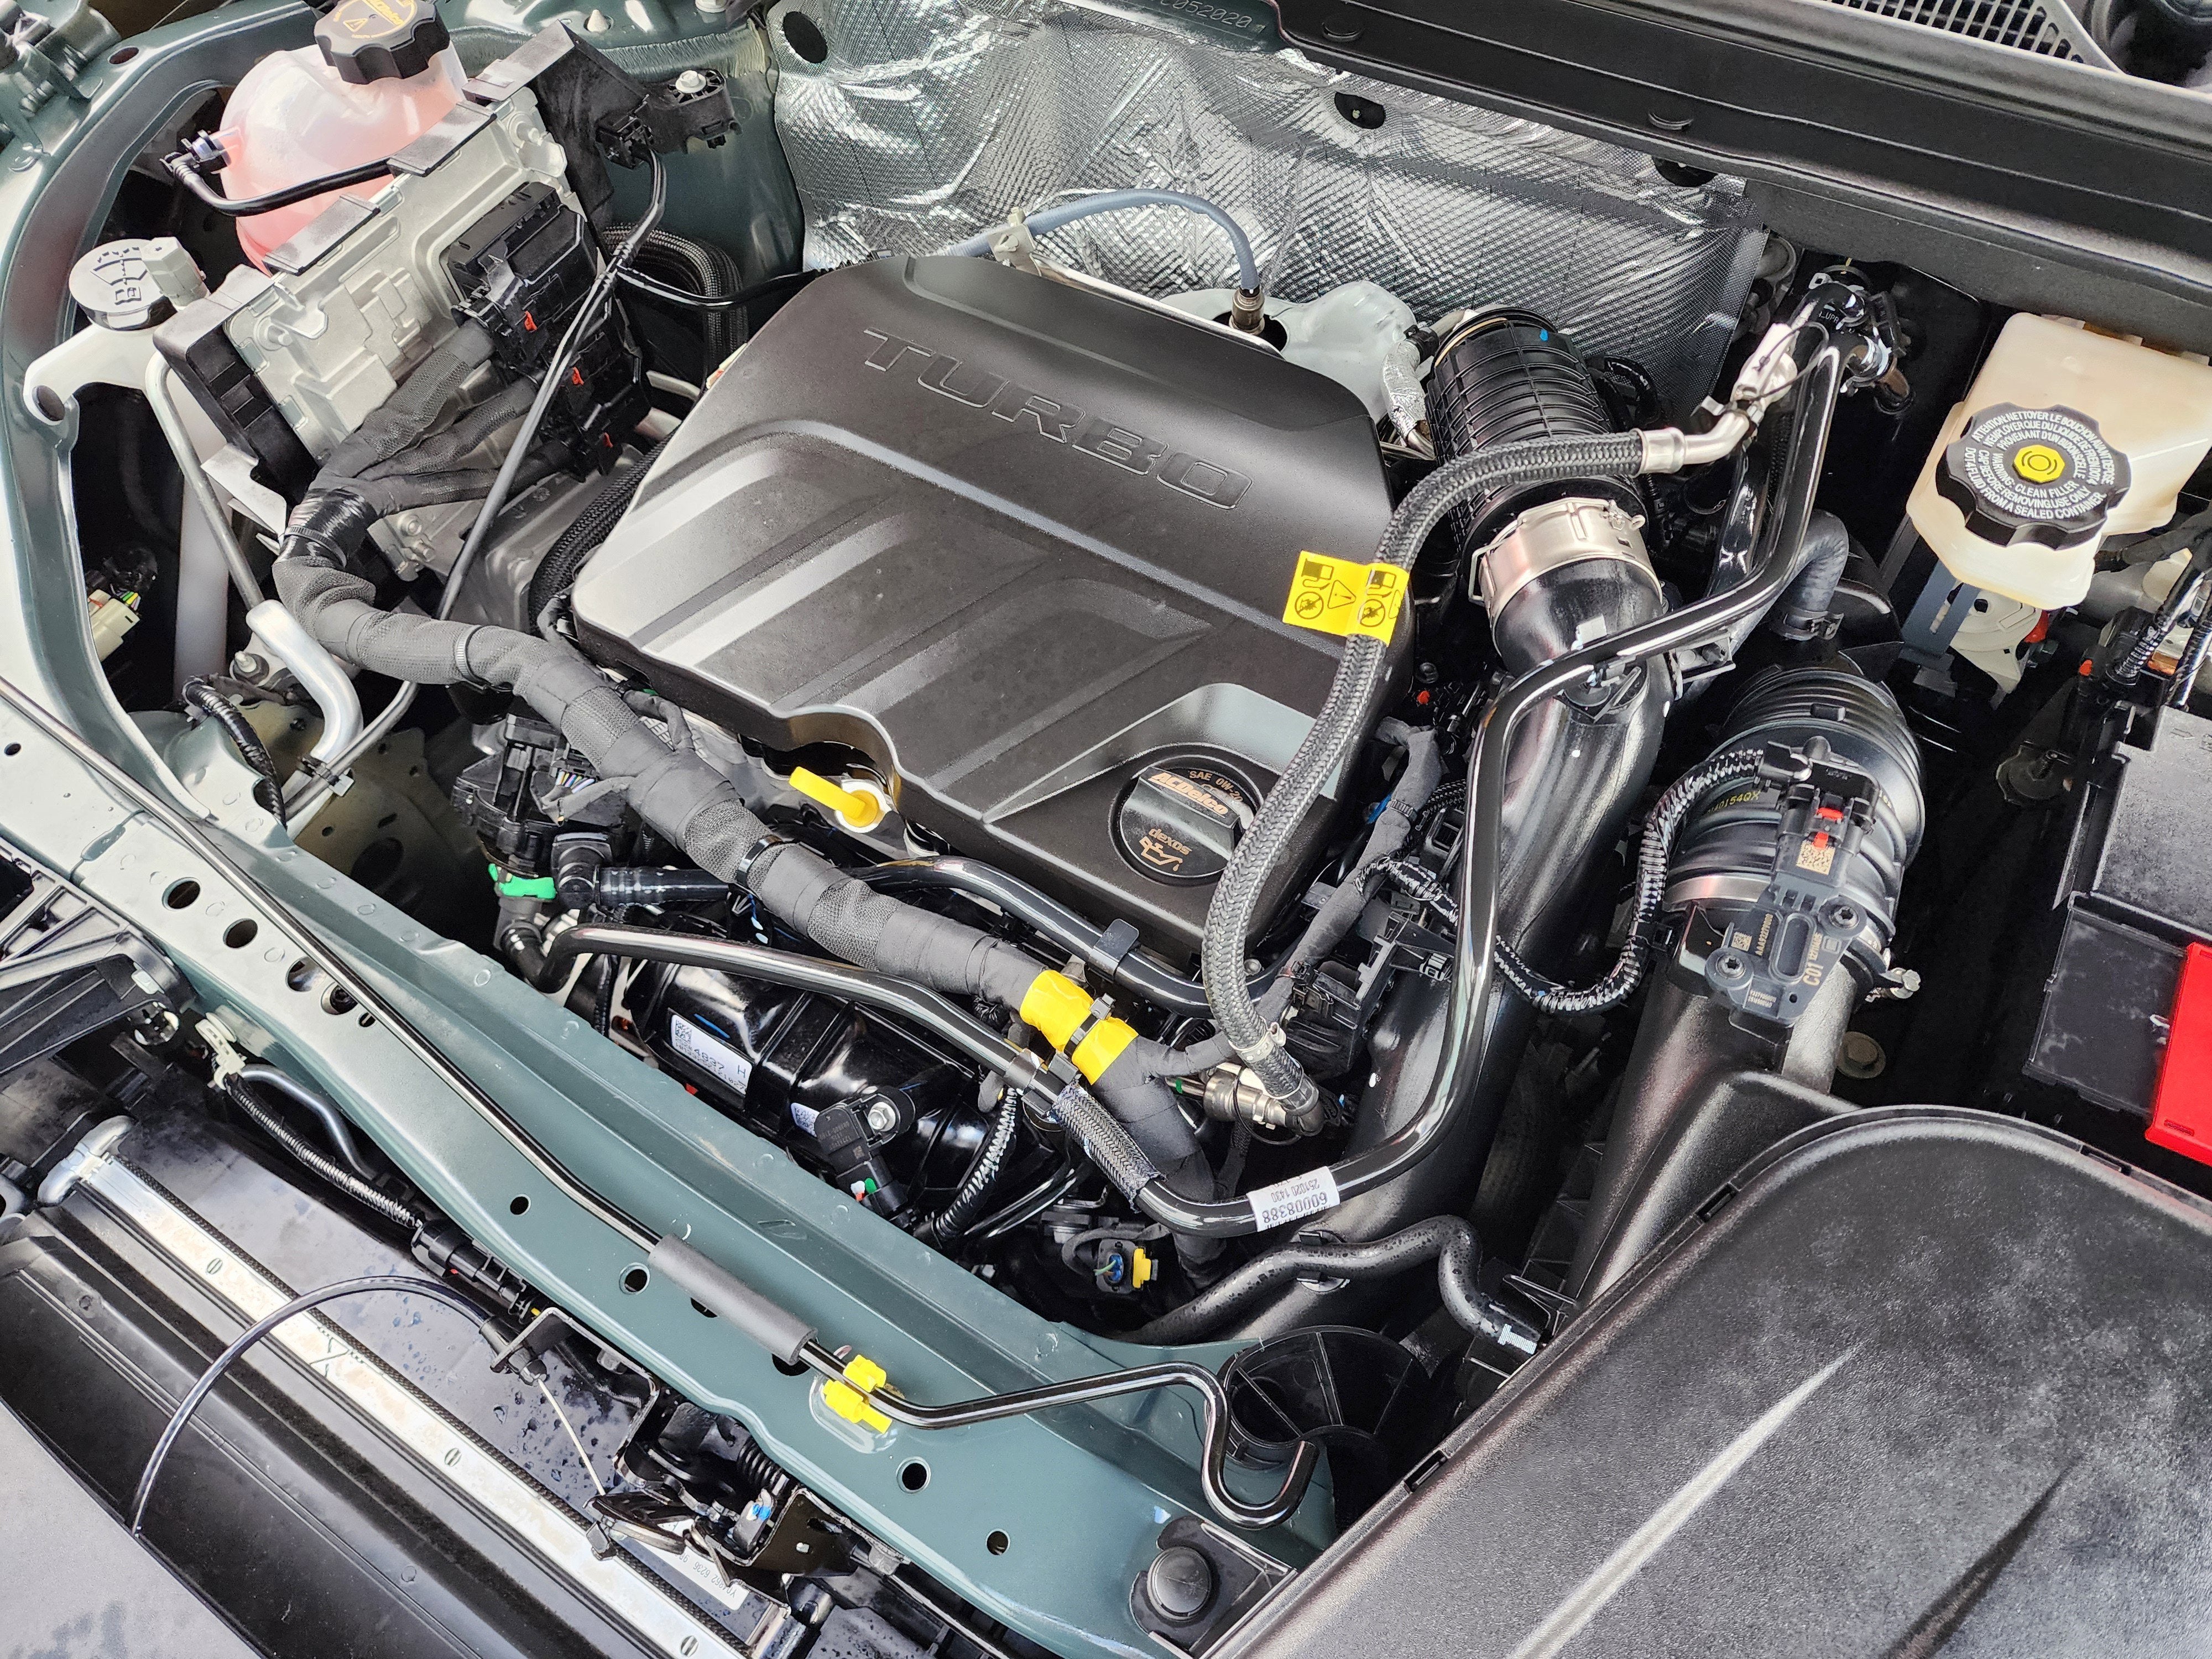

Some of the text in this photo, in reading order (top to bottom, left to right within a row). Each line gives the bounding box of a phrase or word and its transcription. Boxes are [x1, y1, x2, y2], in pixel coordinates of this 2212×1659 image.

[863, 328, 1253, 509] TURBO
[1996, 430, 2041, 451] PROVENANT
[2005, 411, 2048, 421] NETTOYER
[2049, 413, 2062, 423] LE
[2060, 416, 2098, 442] BOUCHON
[2092, 439, 2112, 460] AVANT
[2024, 420, 2041, 429] QUE
[2041, 420, 2054, 431] DU
[2052, 424, 2084, 444] LIQUIDE
[2077, 440, 2092, 451] DE
[1978, 450, 1990, 466] CAP
[1979, 465, 2006, 493] BEFORE
[1992, 453, 2079, 498] WARNING: CLEAN FILLER
[1968, 467, 1986, 489] FLUID
[1980, 487, 2008, 508] FROM
[2005, 502, 2014, 513] A
[2014, 505, 2053, 519] SEALED
[2069, 486, 2091, 504] ONLY
[1149, 772, 1228, 817] ACDelco
[1190, 771, 1244, 802] SAE 0W-20
[1149, 828, 1192, 855] dexos
[1803, 962, 1824, 986] C01
[695, 1048, 724, 1070] 4837
[737, 1065, 746, 1078] H
[1271, 1190, 1290, 1202] 1430
[1291, 1178, 1320, 1196] 251020
[1262, 1191, 1328, 1223] 60008388
[693, 1561, 711, 1578] 6236
